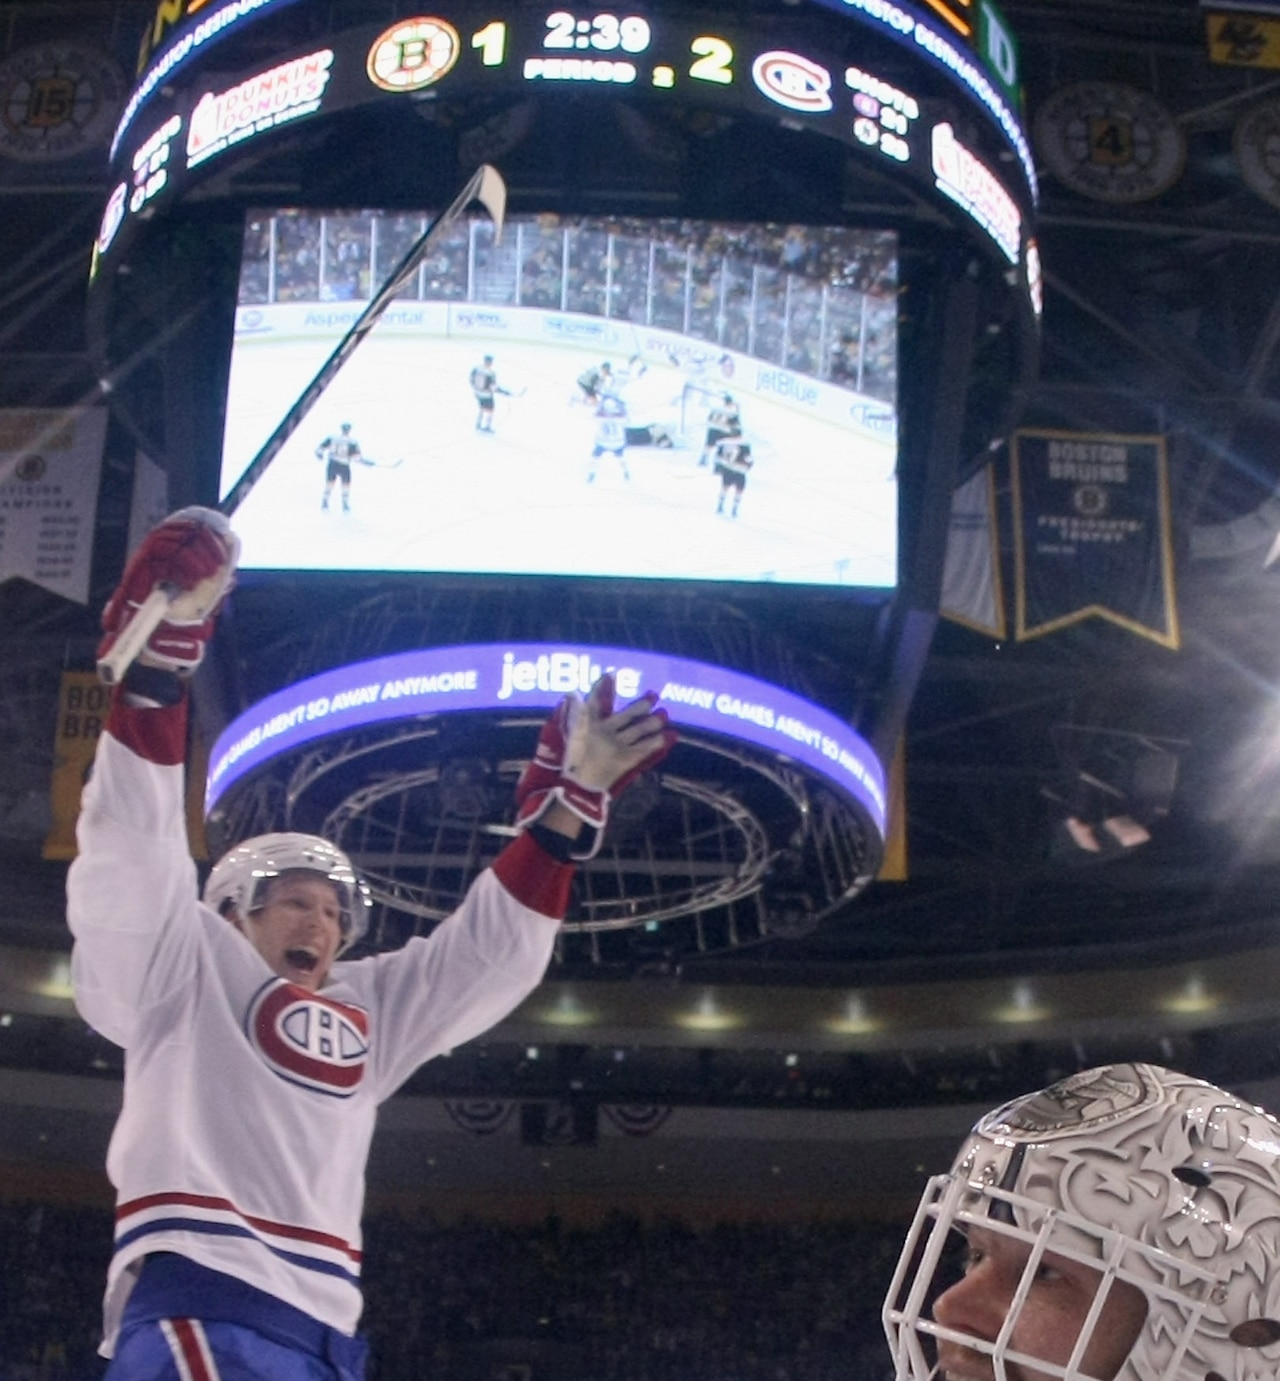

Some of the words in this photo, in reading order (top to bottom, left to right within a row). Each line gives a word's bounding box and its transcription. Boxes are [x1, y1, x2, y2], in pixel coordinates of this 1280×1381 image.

[471, 21, 506, 66] 1
[543, 12, 650, 52] 2:39
[523, 58, 637, 83] PERIOD
[688, 37, 734, 85] 2
[223, 77, 318, 130] DONUTS
[1048, 461, 1129, 484] BRUINS
[305, 697, 331, 721] SO
[330, 684, 382, 713] AWAY
[381, 670, 478, 701] ANYMORE
[659, 682, 715, 712] AWAY
[715, 693, 775, 730] GAMES
